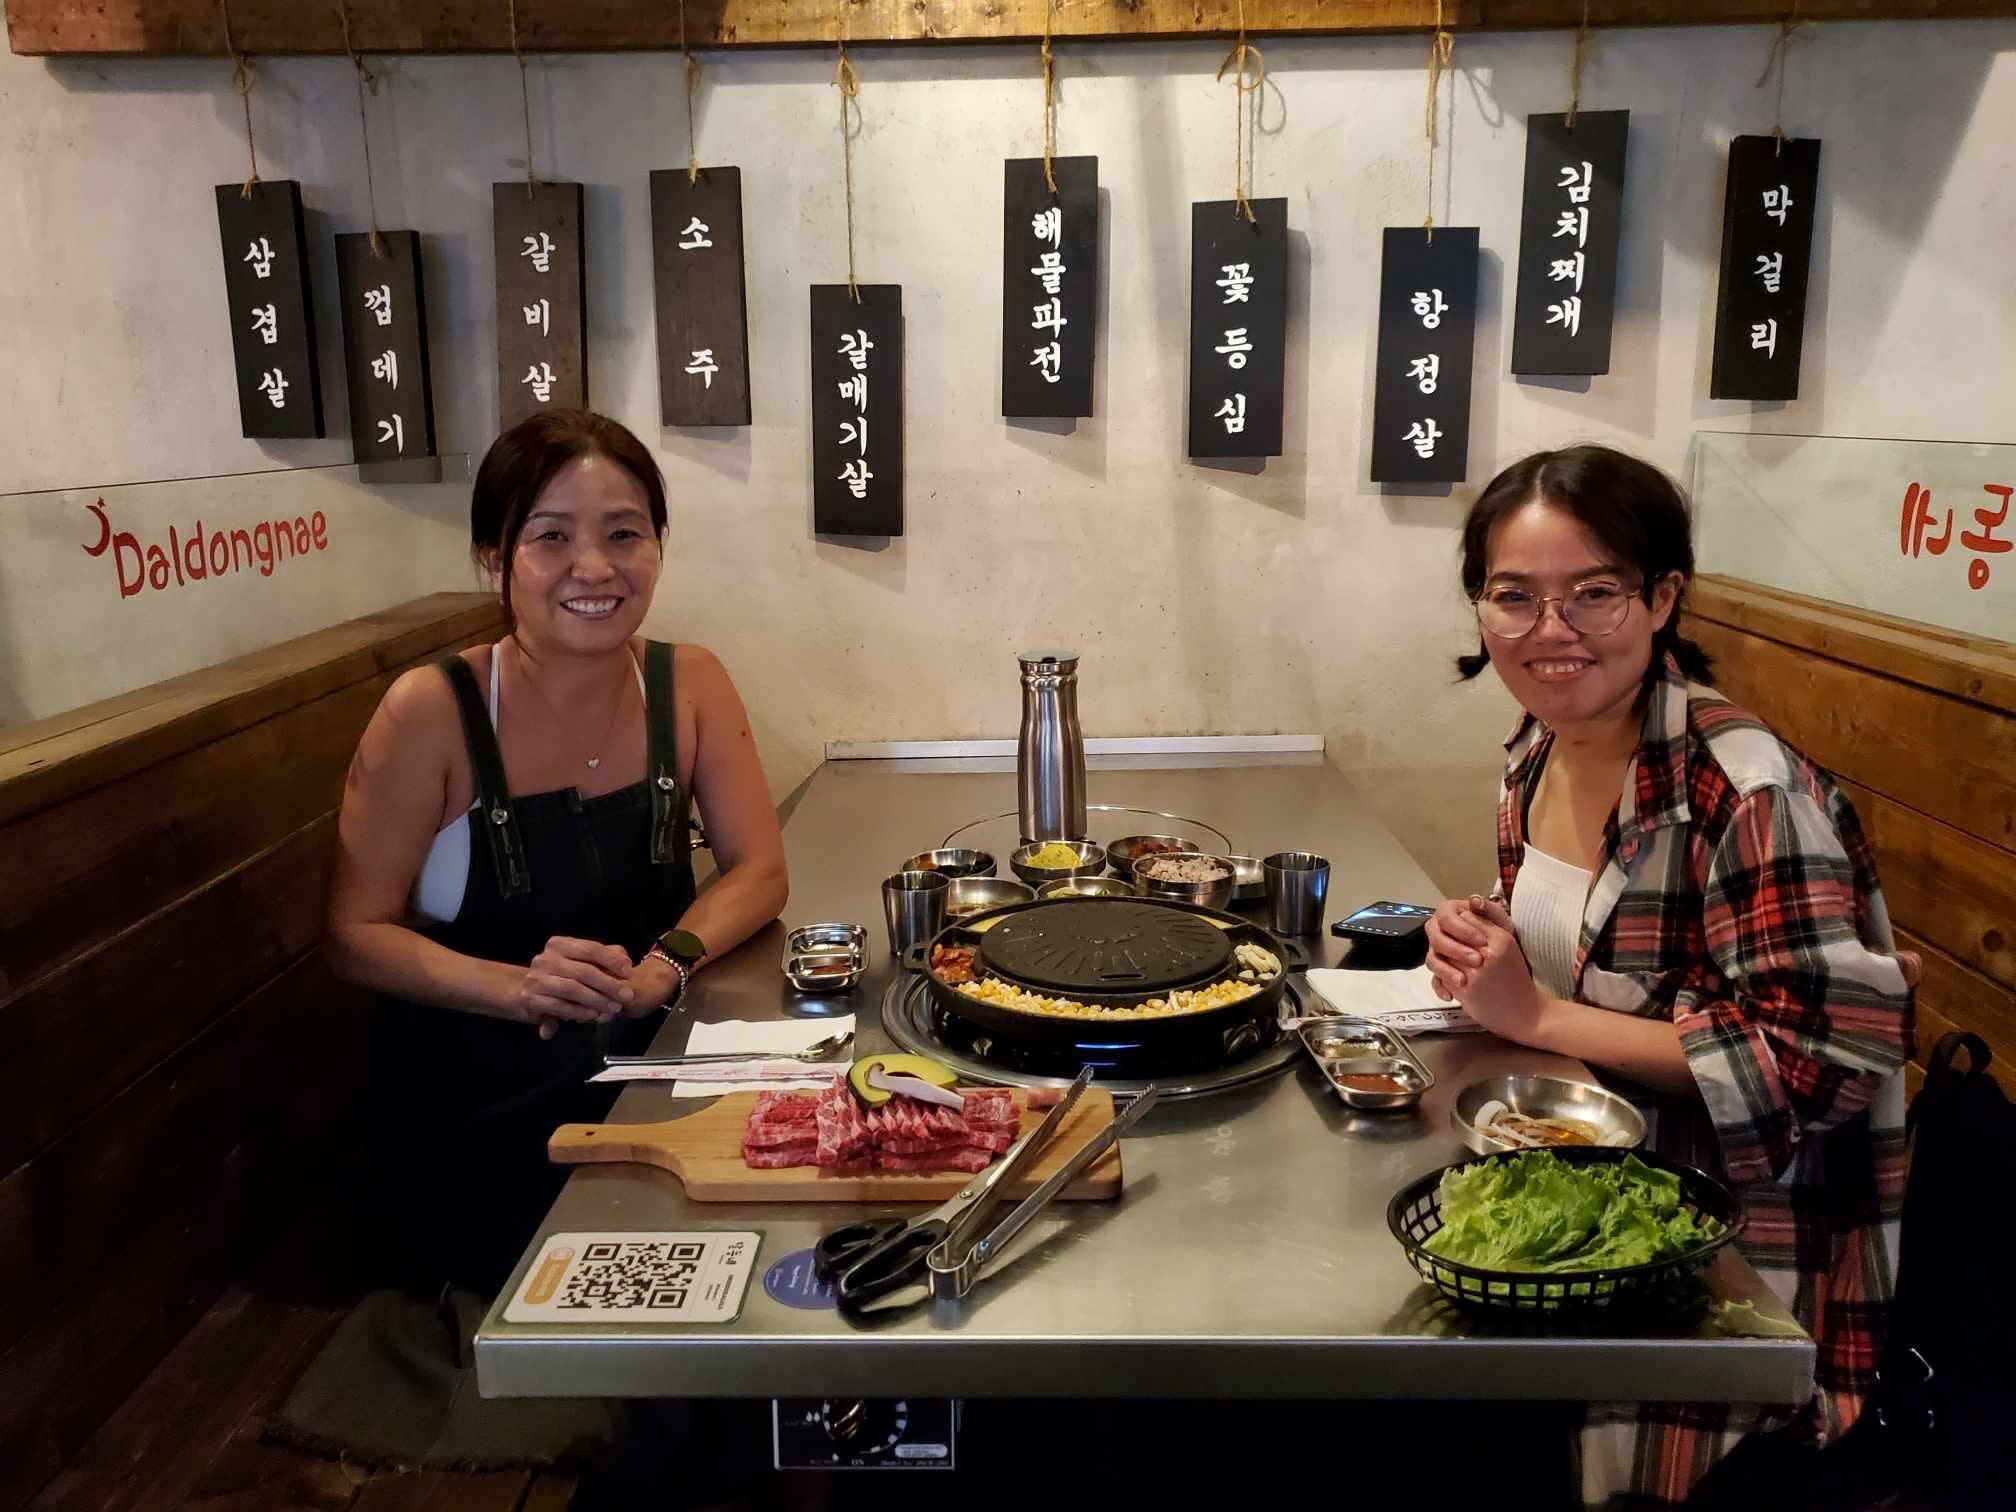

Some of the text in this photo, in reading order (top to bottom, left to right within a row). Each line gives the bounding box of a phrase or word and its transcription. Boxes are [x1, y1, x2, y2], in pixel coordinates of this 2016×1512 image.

[243, 237, 288, 409] 삼겹살
[521, 232, 557, 403] 갈비살
[679, 217, 719, 389] 소주
[1030, 207, 1068, 383] 해물파전
[1546, 162, 1592, 337] 김치찌개
[1751, 185, 1794, 360] 막걸리
[364, 285, 404, 453] 껍데기
[838, 329, 874, 498] 갈매기살
[1215, 263, 1254, 434] 꽃등심
[1402, 289, 1448, 459] 항정살
[111, 511, 328, 599] Daldongnae
